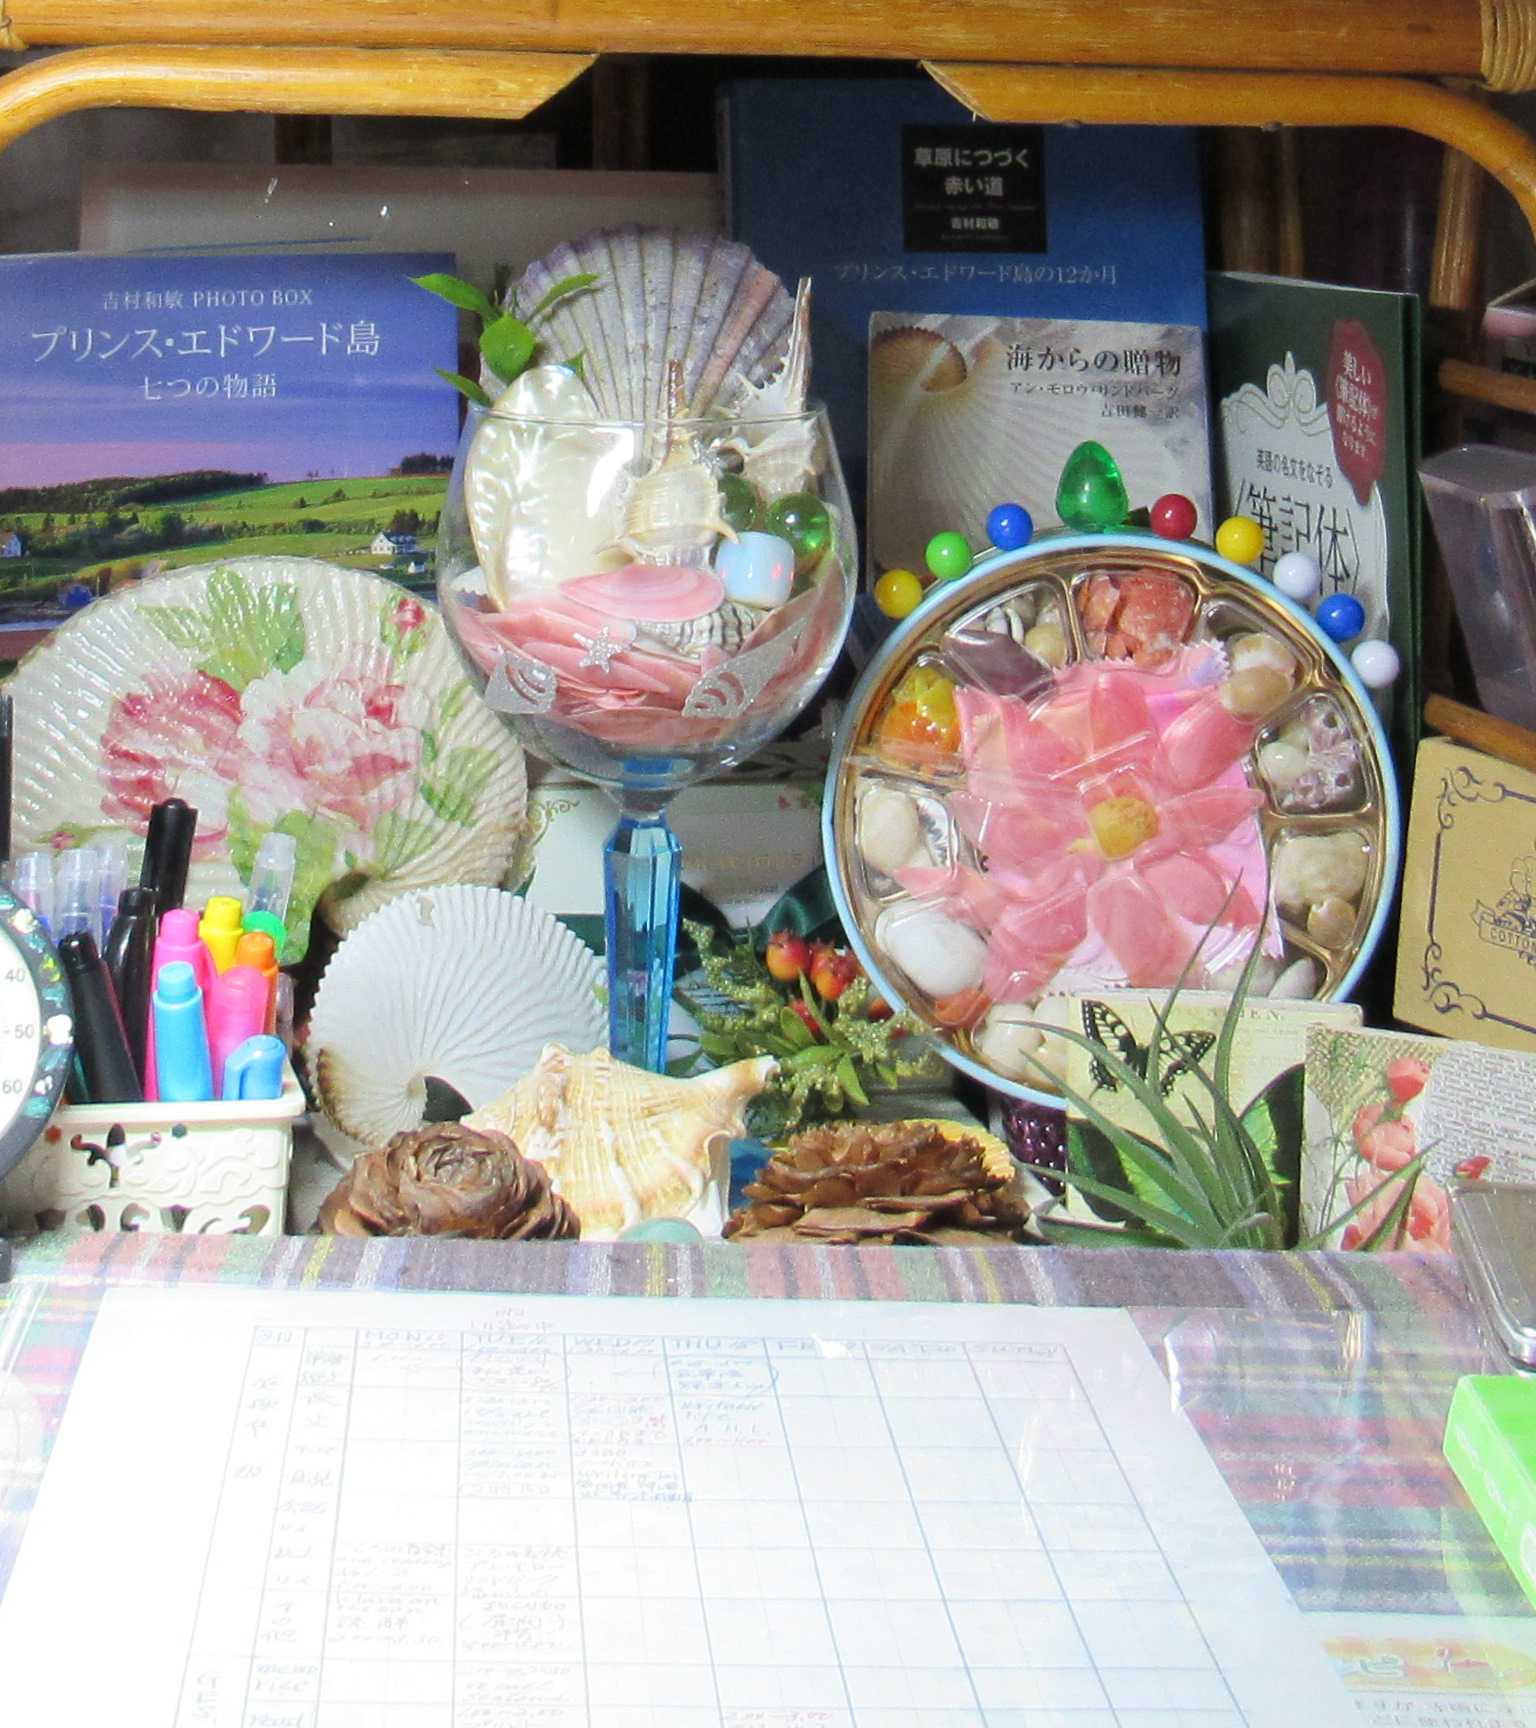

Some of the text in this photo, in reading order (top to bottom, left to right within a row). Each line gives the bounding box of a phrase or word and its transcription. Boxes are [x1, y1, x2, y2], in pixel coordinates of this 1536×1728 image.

[913, 145, 1032, 171] 草原につづく
[944, 175, 1005, 198] 赤い道
[834, 263, 1119, 286] プリンス・エドワード島の12か月
[102, 288, 314, 312] 吉村和敏 PHOTO BOX
[31, 319, 382, 363] プリンス・エドワード島
[1006, 342, 1183, 379] 海からの贈物
[143, 373, 278, 401] 七つの物語
[5, 968, 27, 984] 40
[13, 1024, 35, 1040] 50
[1, 1079, 23, 1095] 60
